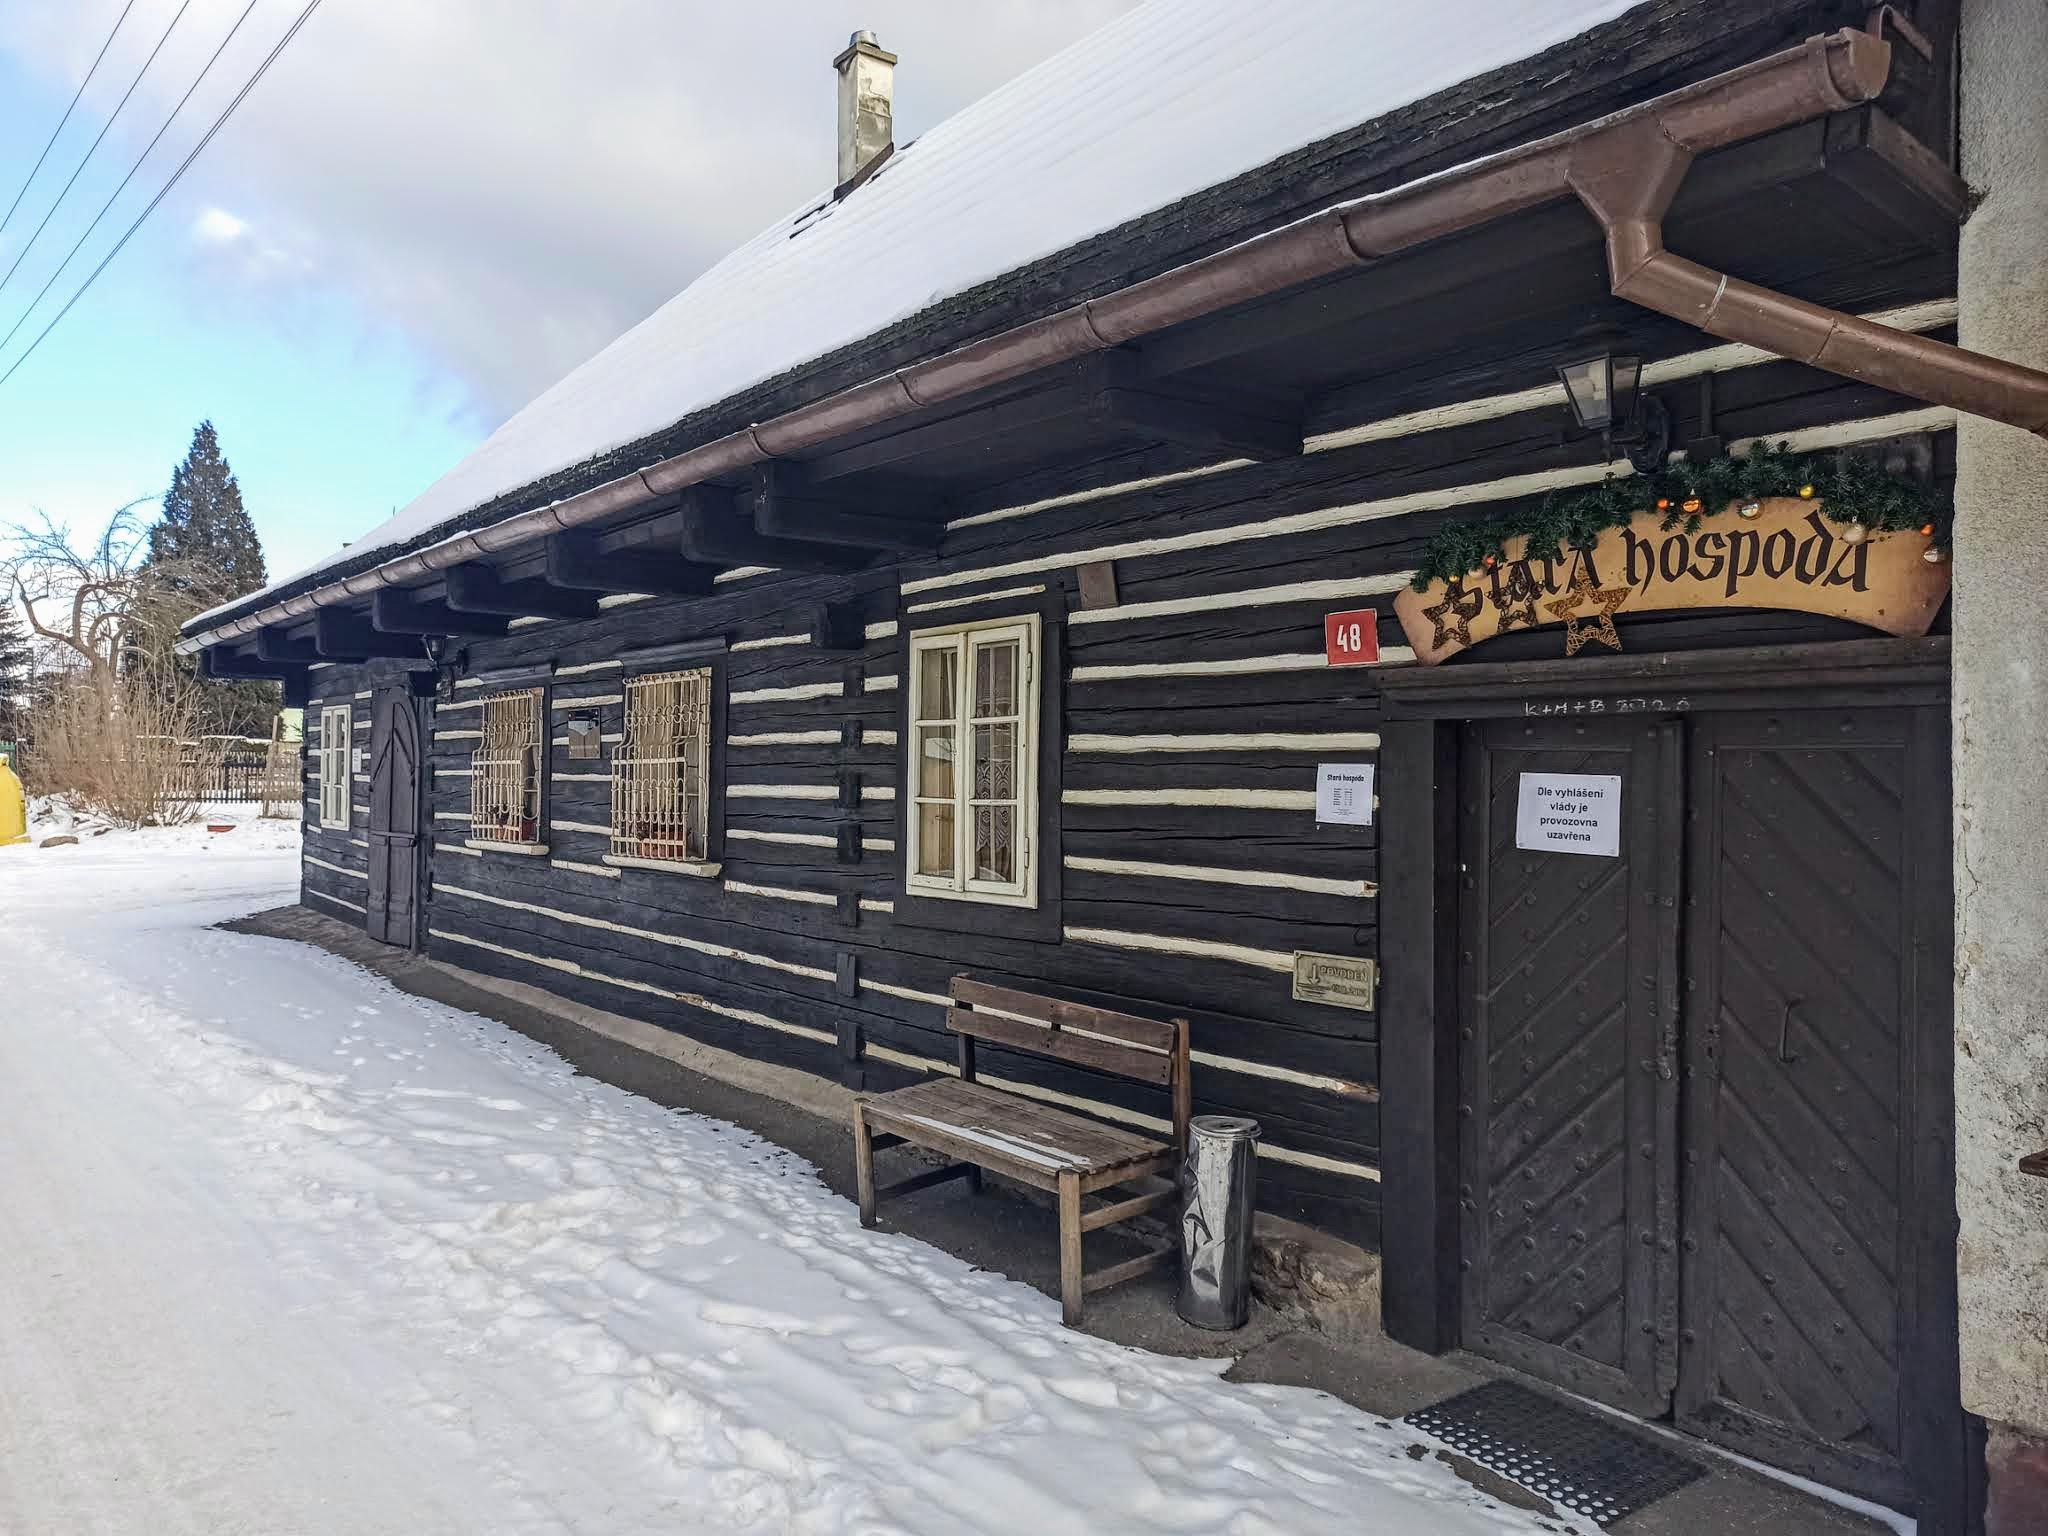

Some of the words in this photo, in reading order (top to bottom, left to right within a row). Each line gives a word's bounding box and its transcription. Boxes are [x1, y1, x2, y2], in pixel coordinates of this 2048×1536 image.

[1618, 508, 1876, 599] hospoda
[1336, 622, 1362, 653] 48
[1343, 774, 1364, 783] hospoda
[1537, 787, 1553, 796] Dle
[1550, 802, 1577, 814] vlády
[1578, 803, 1588, 814] je
[1540, 817, 1598, 827] provozovna
[1546, 831, 1592, 842] uzavřena
